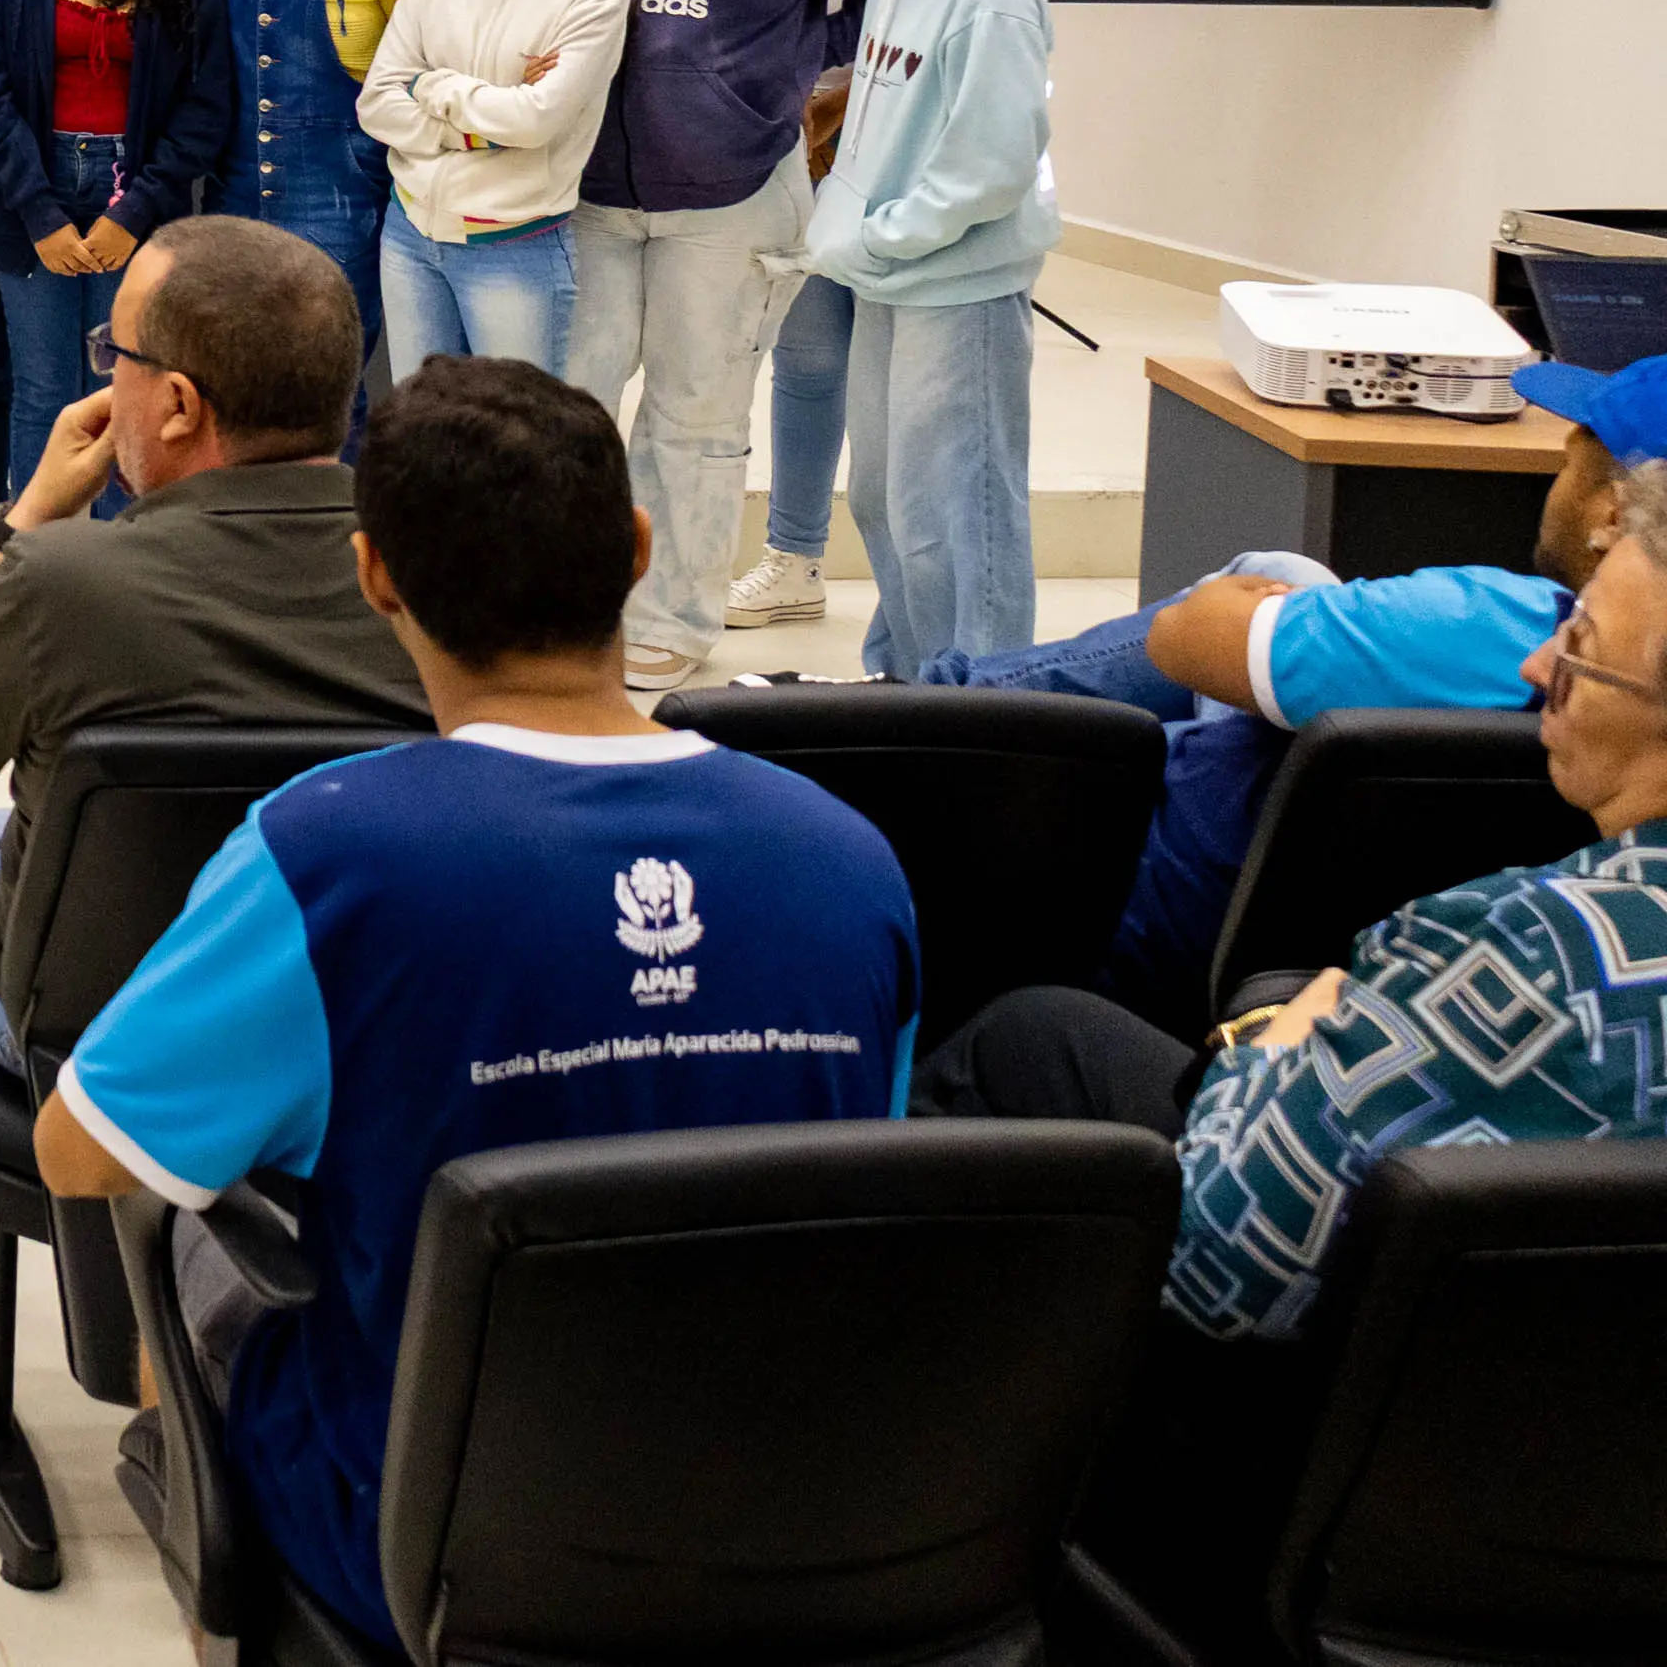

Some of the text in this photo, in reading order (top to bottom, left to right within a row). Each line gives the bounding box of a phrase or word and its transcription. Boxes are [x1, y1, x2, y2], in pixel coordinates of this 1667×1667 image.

[630, 965, 697, 995] APAE
[471, 1053, 536, 1084] Escola
[538, 1038, 610, 1075] Especial
[612, 1034, 662, 1060] Maria
[665, 1030, 762, 1058] Aparecida
